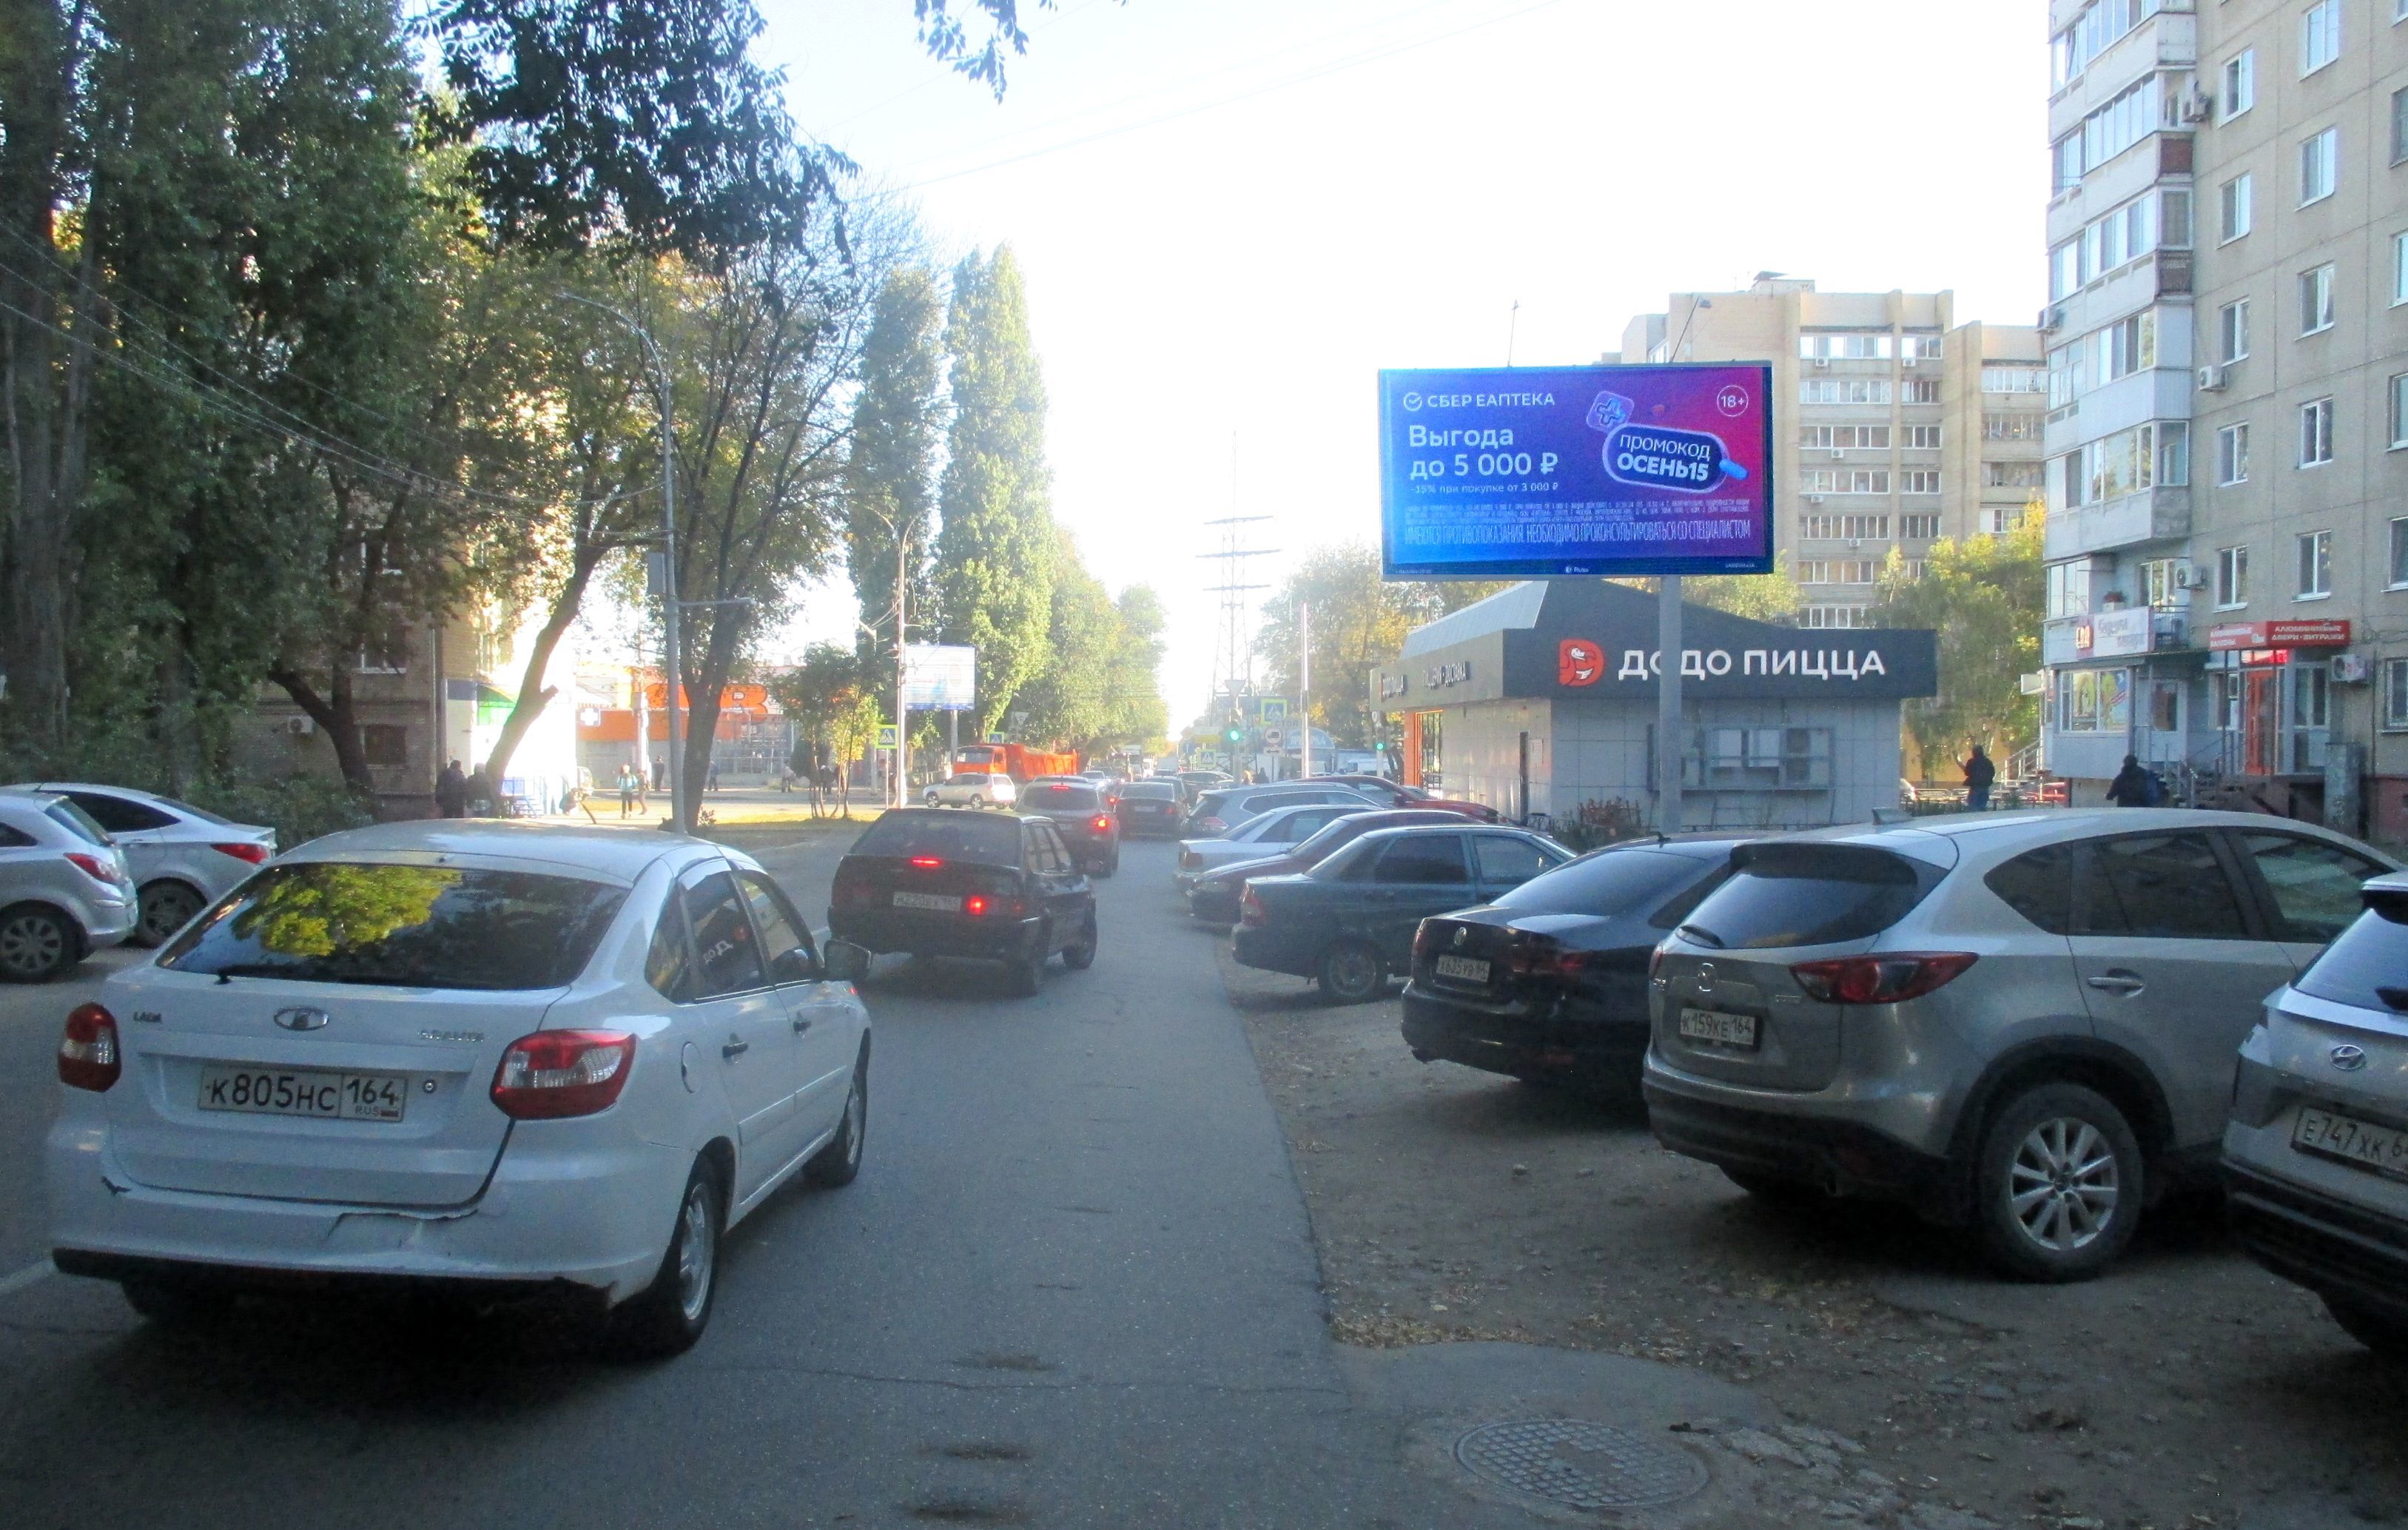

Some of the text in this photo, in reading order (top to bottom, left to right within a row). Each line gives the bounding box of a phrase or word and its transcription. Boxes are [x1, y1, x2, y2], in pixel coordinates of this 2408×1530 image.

[1427, 392, 1555, 408] СБЕР ЕАПТЕКА
[1721, 395, 1746, 408] 18+
[1409, 424, 1514, 449] Выгода
[1410, 459, 1445, 480] до
[1617, 452, 1709, 482] ОСЕНЬ15
[1440, 485, 1459, 497] при
[1462, 484, 1504, 494] покупке
[1507, 484, 1519, 492] от
[1689, 518, 1751, 542] СПЕЦИАЛИСТОМ
[1743, 649, 1886, 681] ПИЦЦА
[211, 1073, 399, 1111] К805НС 164
[354, 1104, 380, 1116] RUS
